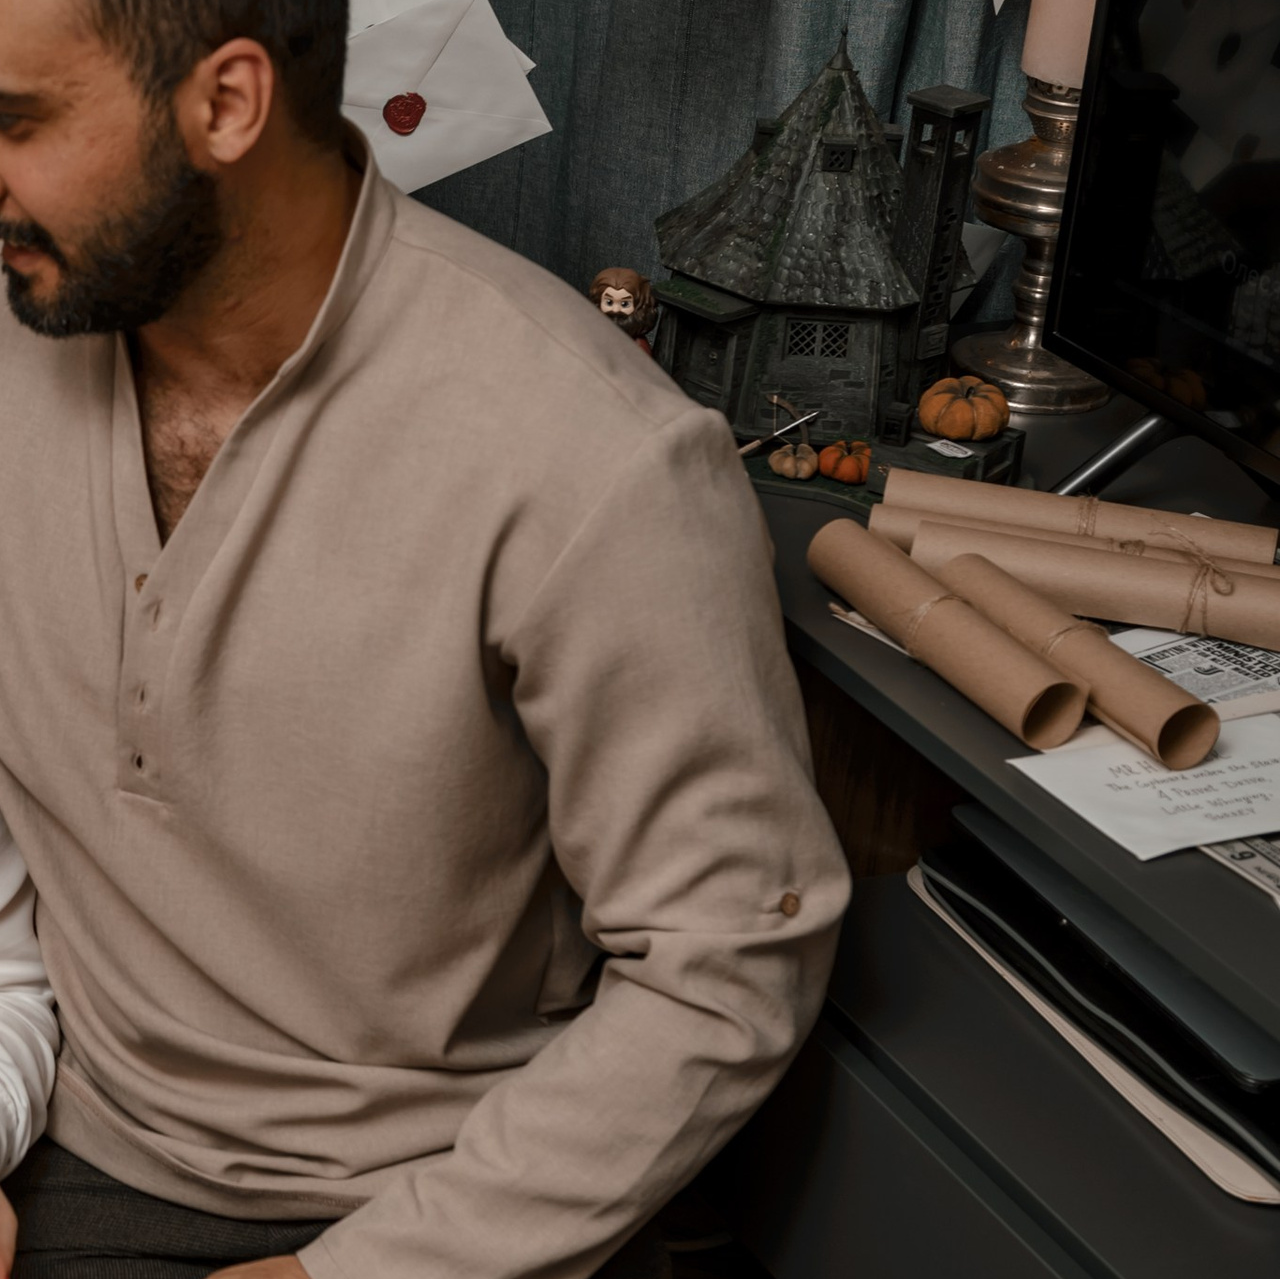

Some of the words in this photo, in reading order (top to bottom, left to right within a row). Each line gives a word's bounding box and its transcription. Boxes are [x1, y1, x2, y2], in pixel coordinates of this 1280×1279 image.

[1143, 644, 1191, 662] MEETING
[1202, 646, 1272, 678] SCHEDULED
[1213, 642, 1280, 675] MINISTER
